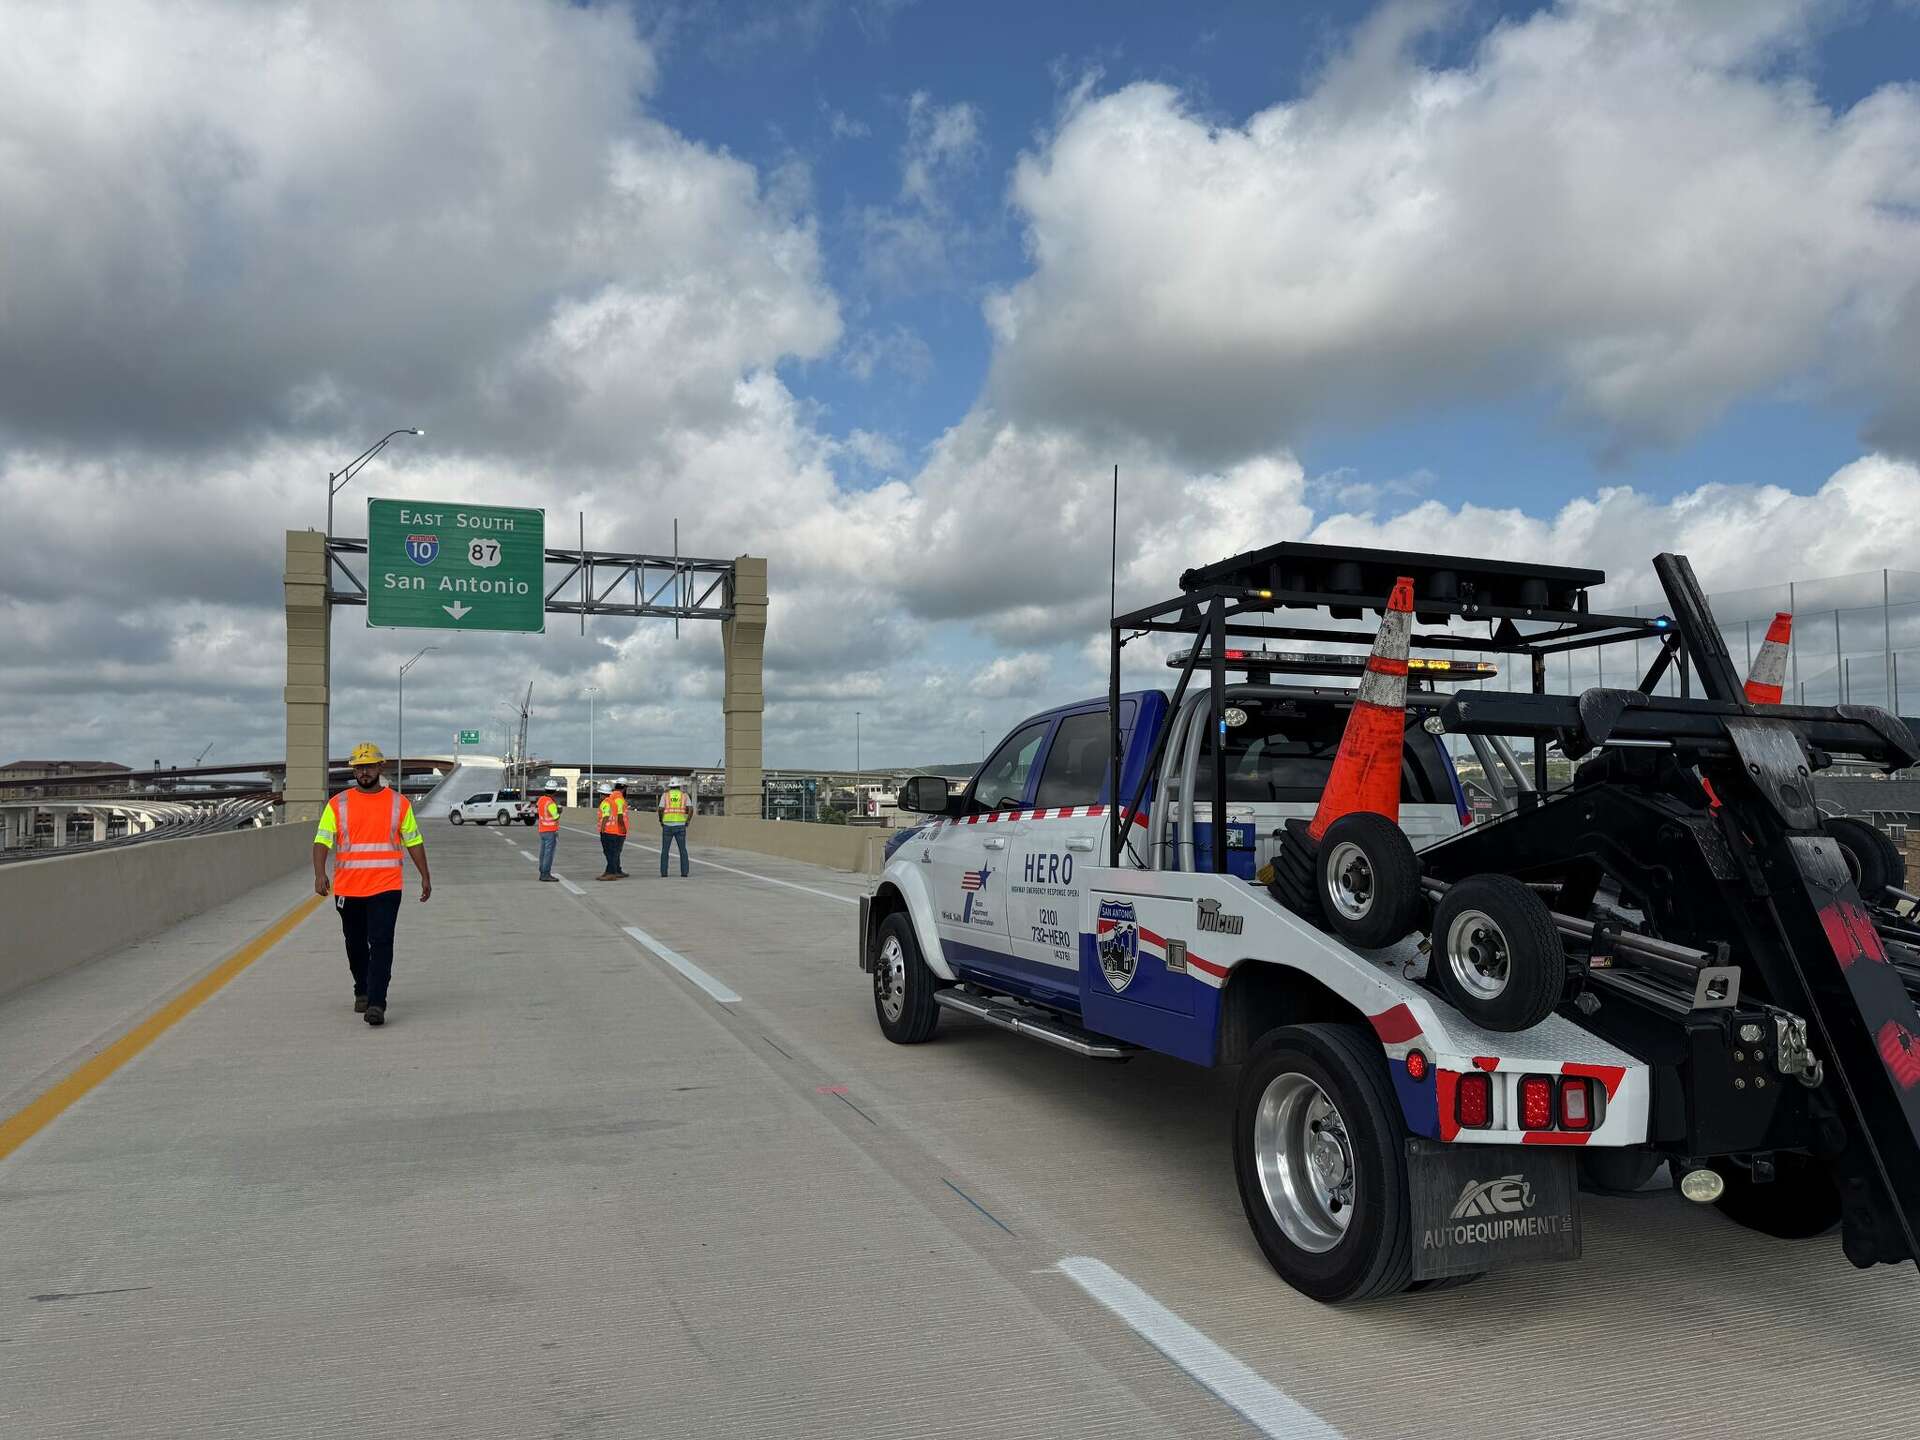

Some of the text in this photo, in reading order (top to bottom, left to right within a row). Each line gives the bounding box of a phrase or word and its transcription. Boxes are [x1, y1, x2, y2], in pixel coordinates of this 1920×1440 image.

[400, 510, 514, 531] EAST SOUTH
[412, 542, 432, 559] 10
[471, 545, 498, 561] 87
[384, 573, 529, 595] San Antonio
[1024, 853, 1073, 885] HERO
[1047, 888, 1066, 897] RESPONSE
[1039, 908, 1058, 926] (210)
[1101, 906, 1111, 917] SAN
[1031, 926, 1071, 947] 732-HERO
[1423, 1215, 1559, 1250] AUTOEQUIPMENT
